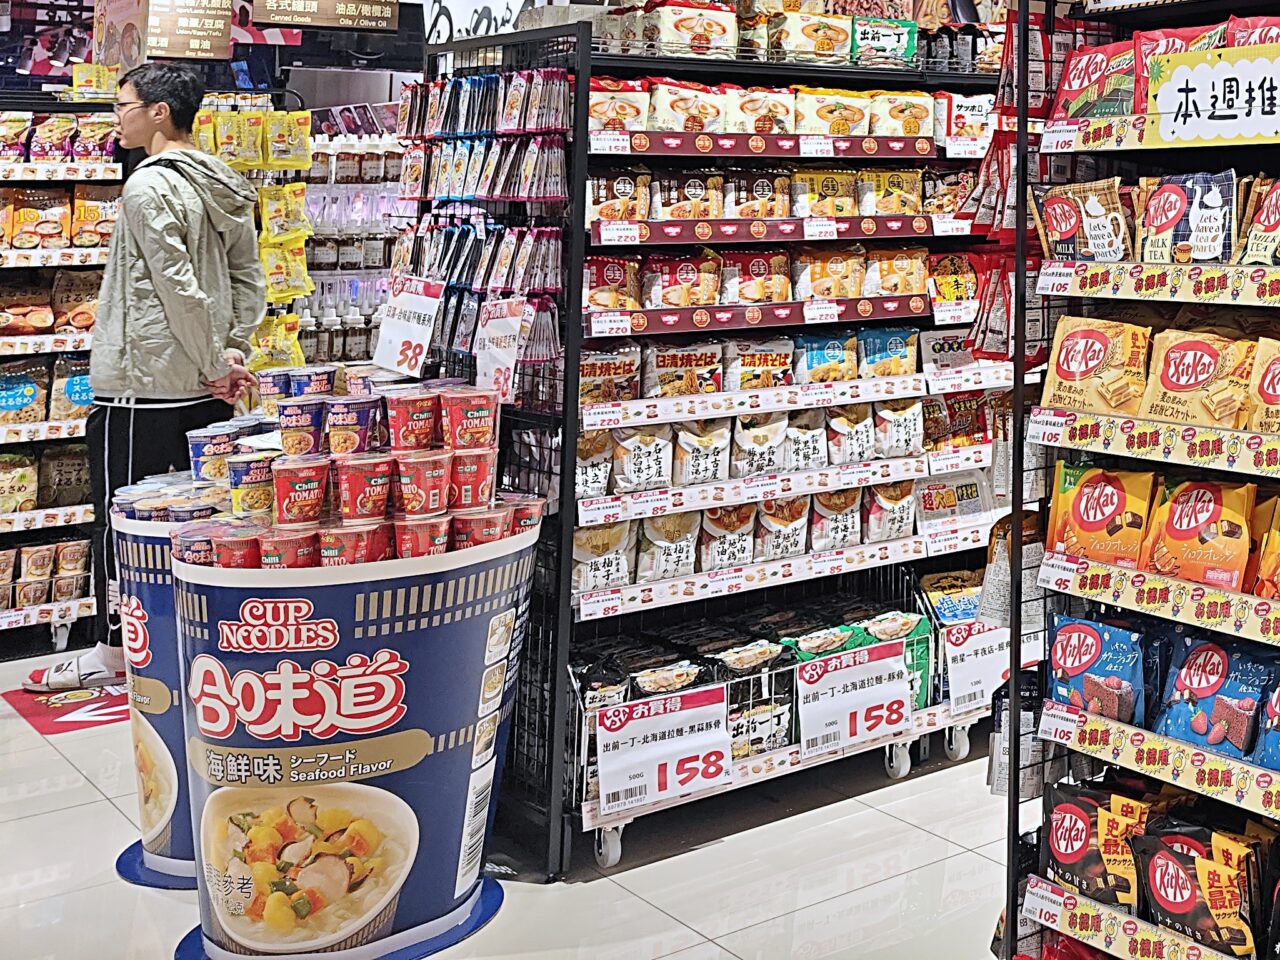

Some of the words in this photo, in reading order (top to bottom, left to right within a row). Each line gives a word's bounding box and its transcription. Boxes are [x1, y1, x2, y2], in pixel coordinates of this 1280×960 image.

[1055, 140, 1072, 149] 105
[1056, 244, 1074, 255] MILK
[1149, 239, 1167, 250] MILK
[1149, 250, 1165, 260] TEA
[1051, 283, 1068, 292] 105
[397, 341, 423, 371] 38
[1063, 340, 1102, 370] KitKat
[1171, 350, 1213, 383] KitKat
[599, 417, 620, 427] 220
[1041, 432, 1059, 442] 105
[763, 491, 776, 499] 85
[604, 512, 620, 522] 85
[653, 505, 668, 515] 85
[1054, 577, 1070, 590] 95
[244, 599, 311, 623] CUP
[219, 620, 338, 651] NOODLES
[827, 650, 869, 672] お買得
[1056, 637, 1096, 667] KitKat
[191, 650, 409, 740] 合味道
[849, 699, 905, 737] 158
[205, 750, 283, 784] 海鮮味
[290, 749, 356, 767] シーフード
[290, 764, 346, 783] Seafood
[349, 757, 393, 778] Flavor
[658, 751, 724, 792] 158
[1054, 817, 1085, 850] KitKat
[1158, 866, 1191, 901] KitKat
